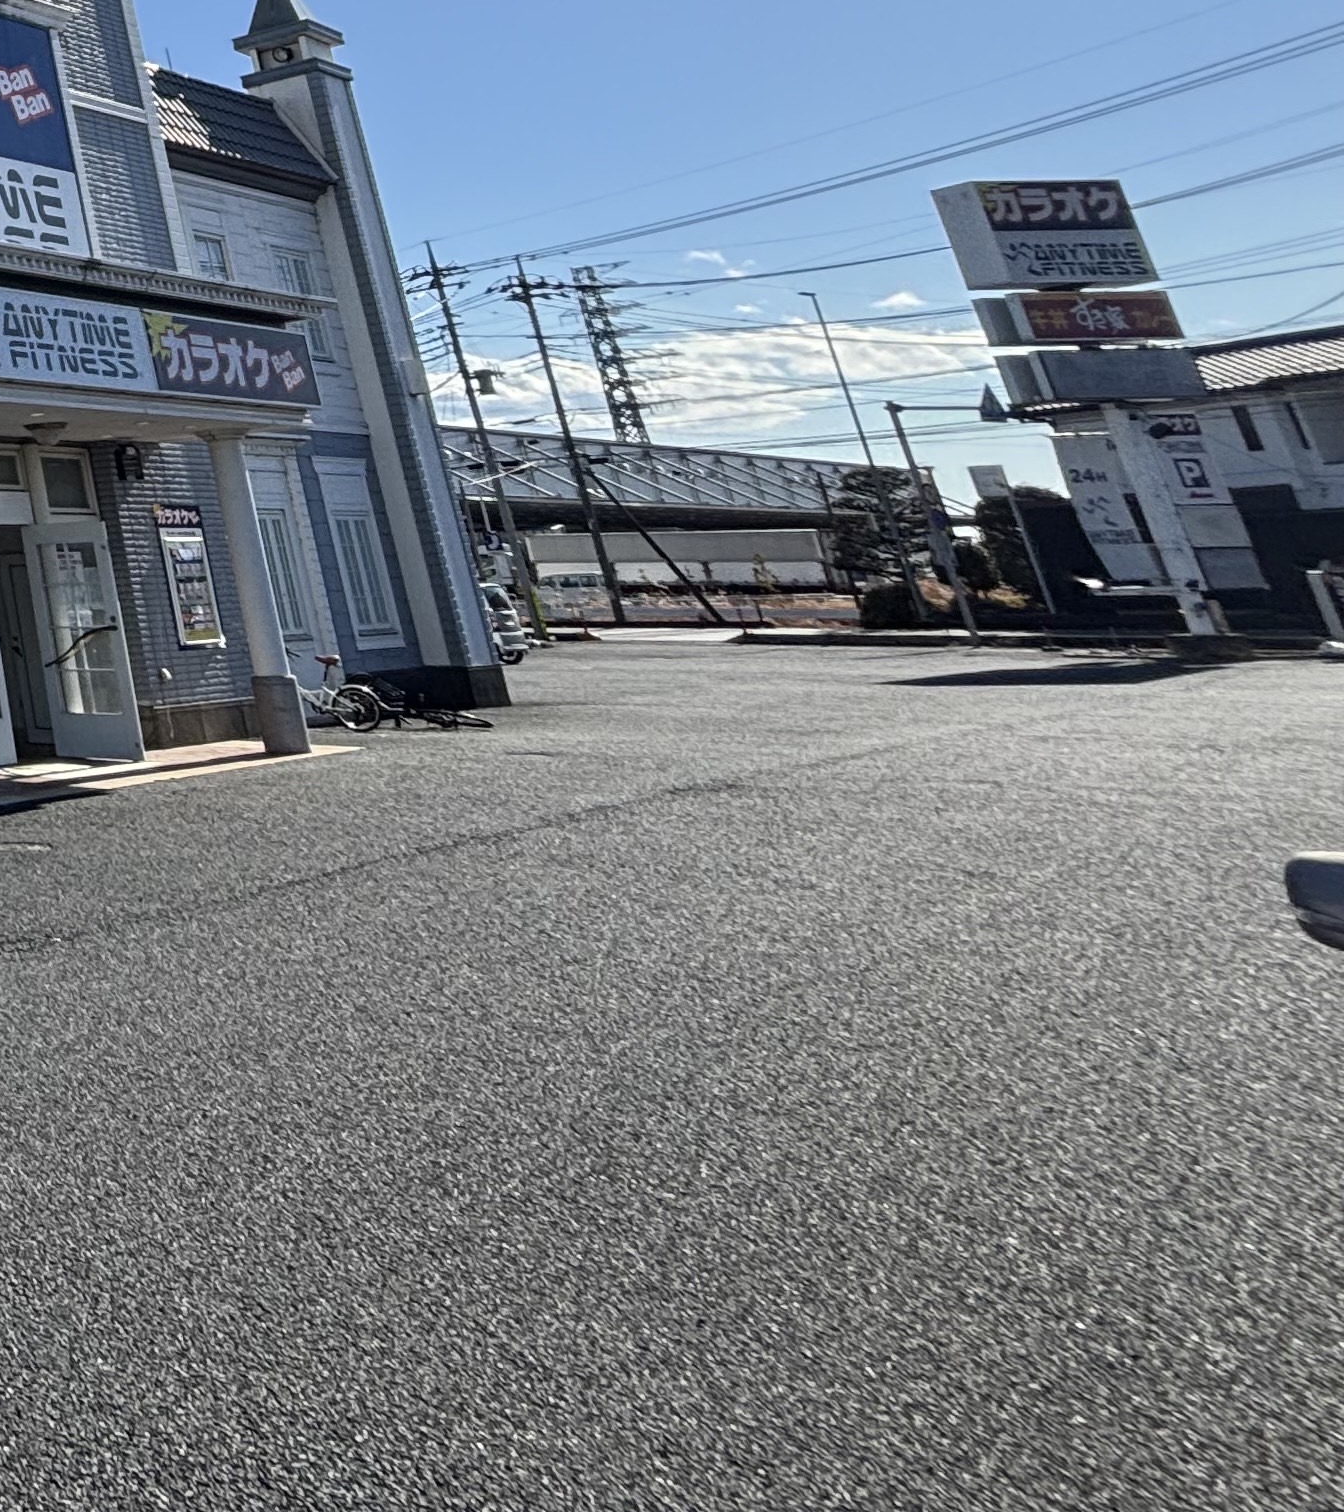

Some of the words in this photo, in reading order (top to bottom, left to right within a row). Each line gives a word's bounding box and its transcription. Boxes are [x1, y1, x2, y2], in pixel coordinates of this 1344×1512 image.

[12, 91, 52, 124] Ban
[984, 186, 1119, 223] カラオケ
[1033, 242, 1143, 262] ANYTIME
[1041, 261, 1149, 277] FITNESS
[2, 301, 133, 350] ANYTIME
[7, 340, 139, 380] FITNESS
[160, 327, 271, 388] カラオケ
[282, 361, 307, 391] Ban
[1069, 468, 1108, 484] 24H
